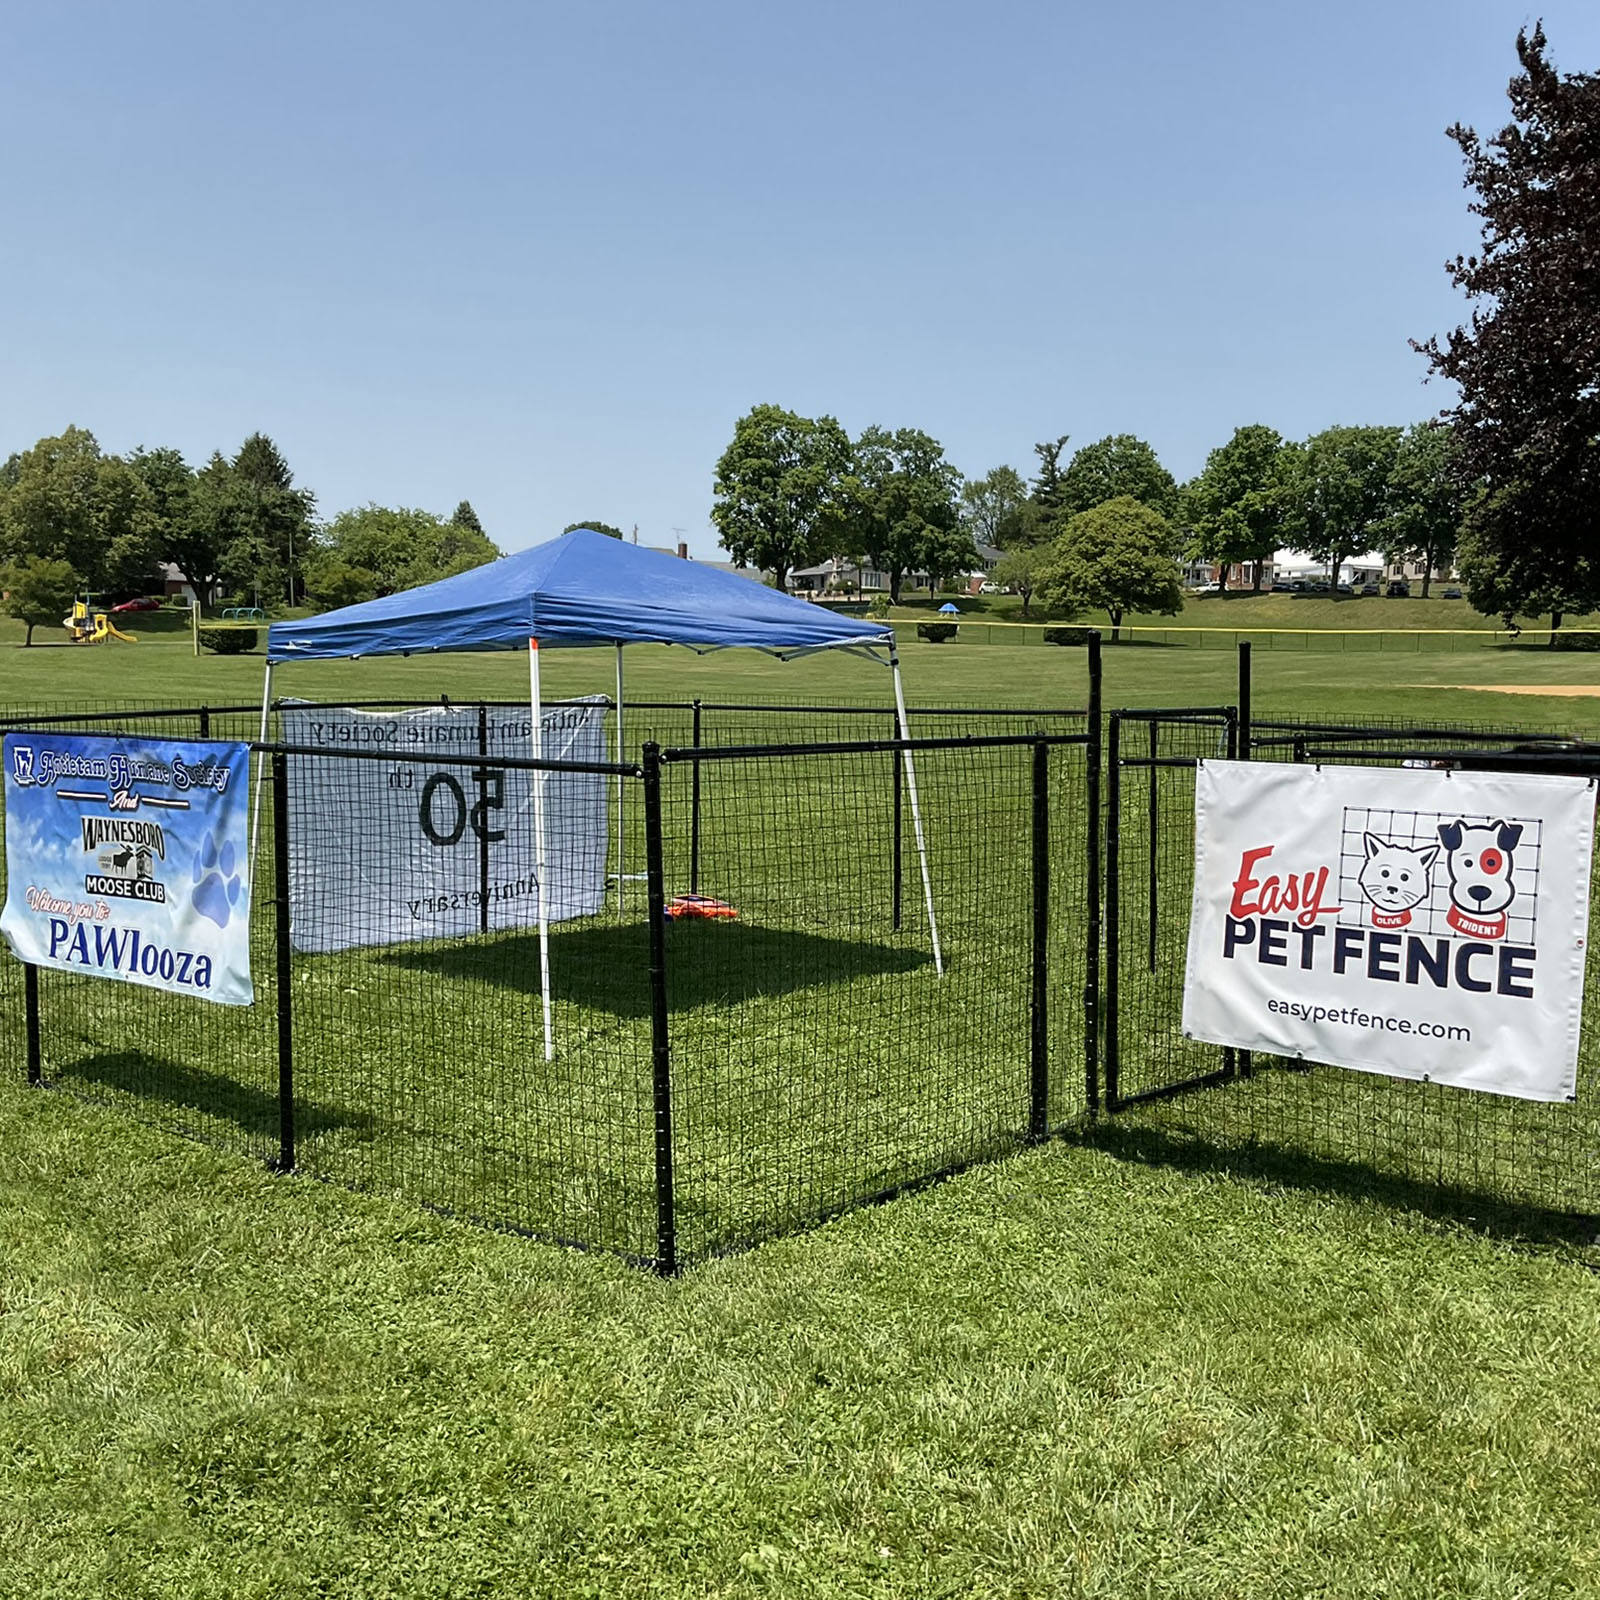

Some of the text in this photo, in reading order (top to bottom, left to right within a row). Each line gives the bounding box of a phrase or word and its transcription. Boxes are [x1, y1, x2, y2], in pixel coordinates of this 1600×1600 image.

[37, 751, 231, 791] Antietam Humane Society
[109, 790, 139, 808] And
[81, 817, 165, 861] WAYNESBORO
[86, 876, 164, 901] MOOSE CLUB
[1230, 845, 1344, 926] Easy
[25, 886, 72, 915] Welcome
[69, 903, 94, 926] you
[1376, 917, 1402, 926] OLIVE
[1456, 917, 1498, 937] TRIDENT
[1223, 914, 1537, 999] PET FENCE
[1267, 998, 1472, 1042] easypetfence.com
